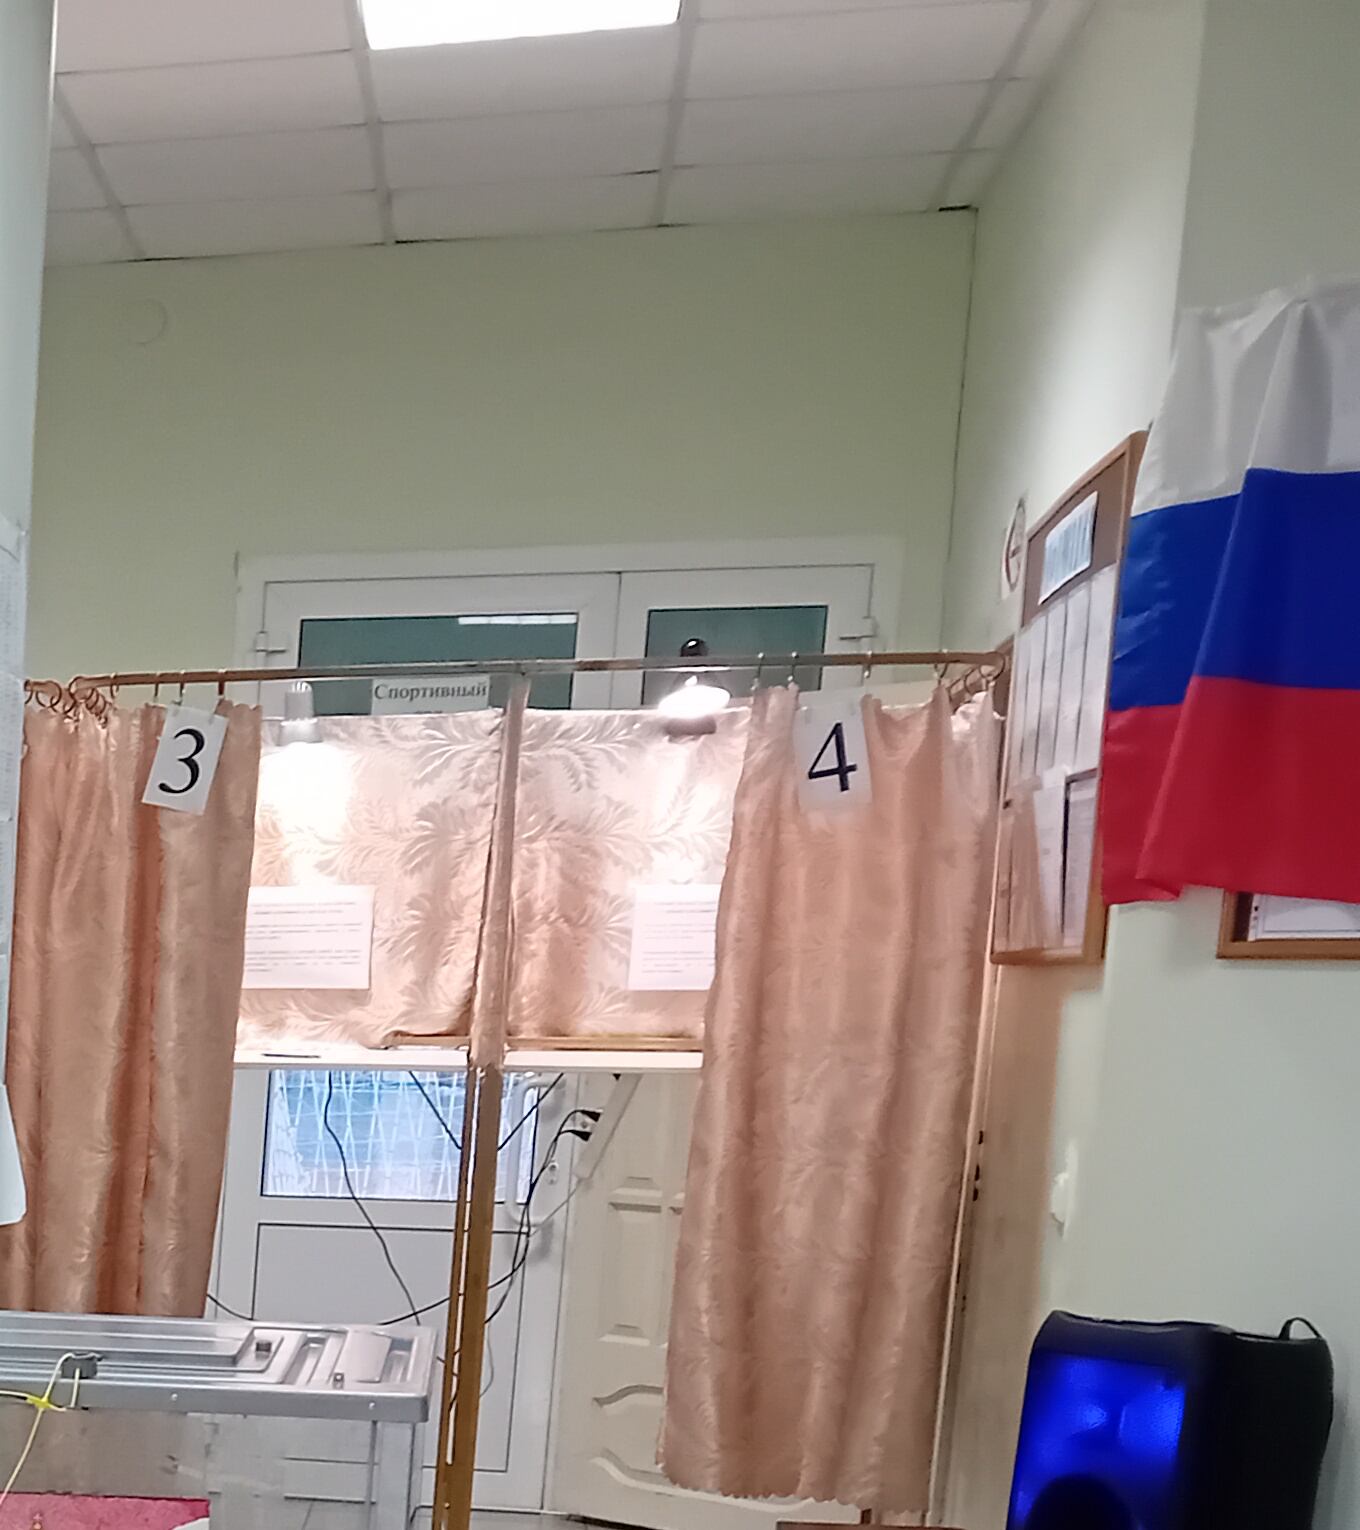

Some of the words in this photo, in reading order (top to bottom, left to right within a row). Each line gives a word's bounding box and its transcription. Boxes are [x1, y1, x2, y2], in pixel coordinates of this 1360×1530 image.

[374, 681, 488, 702] Спортивный
[158, 728, 205, 794] 3
[808, 722, 857, 792] 4
